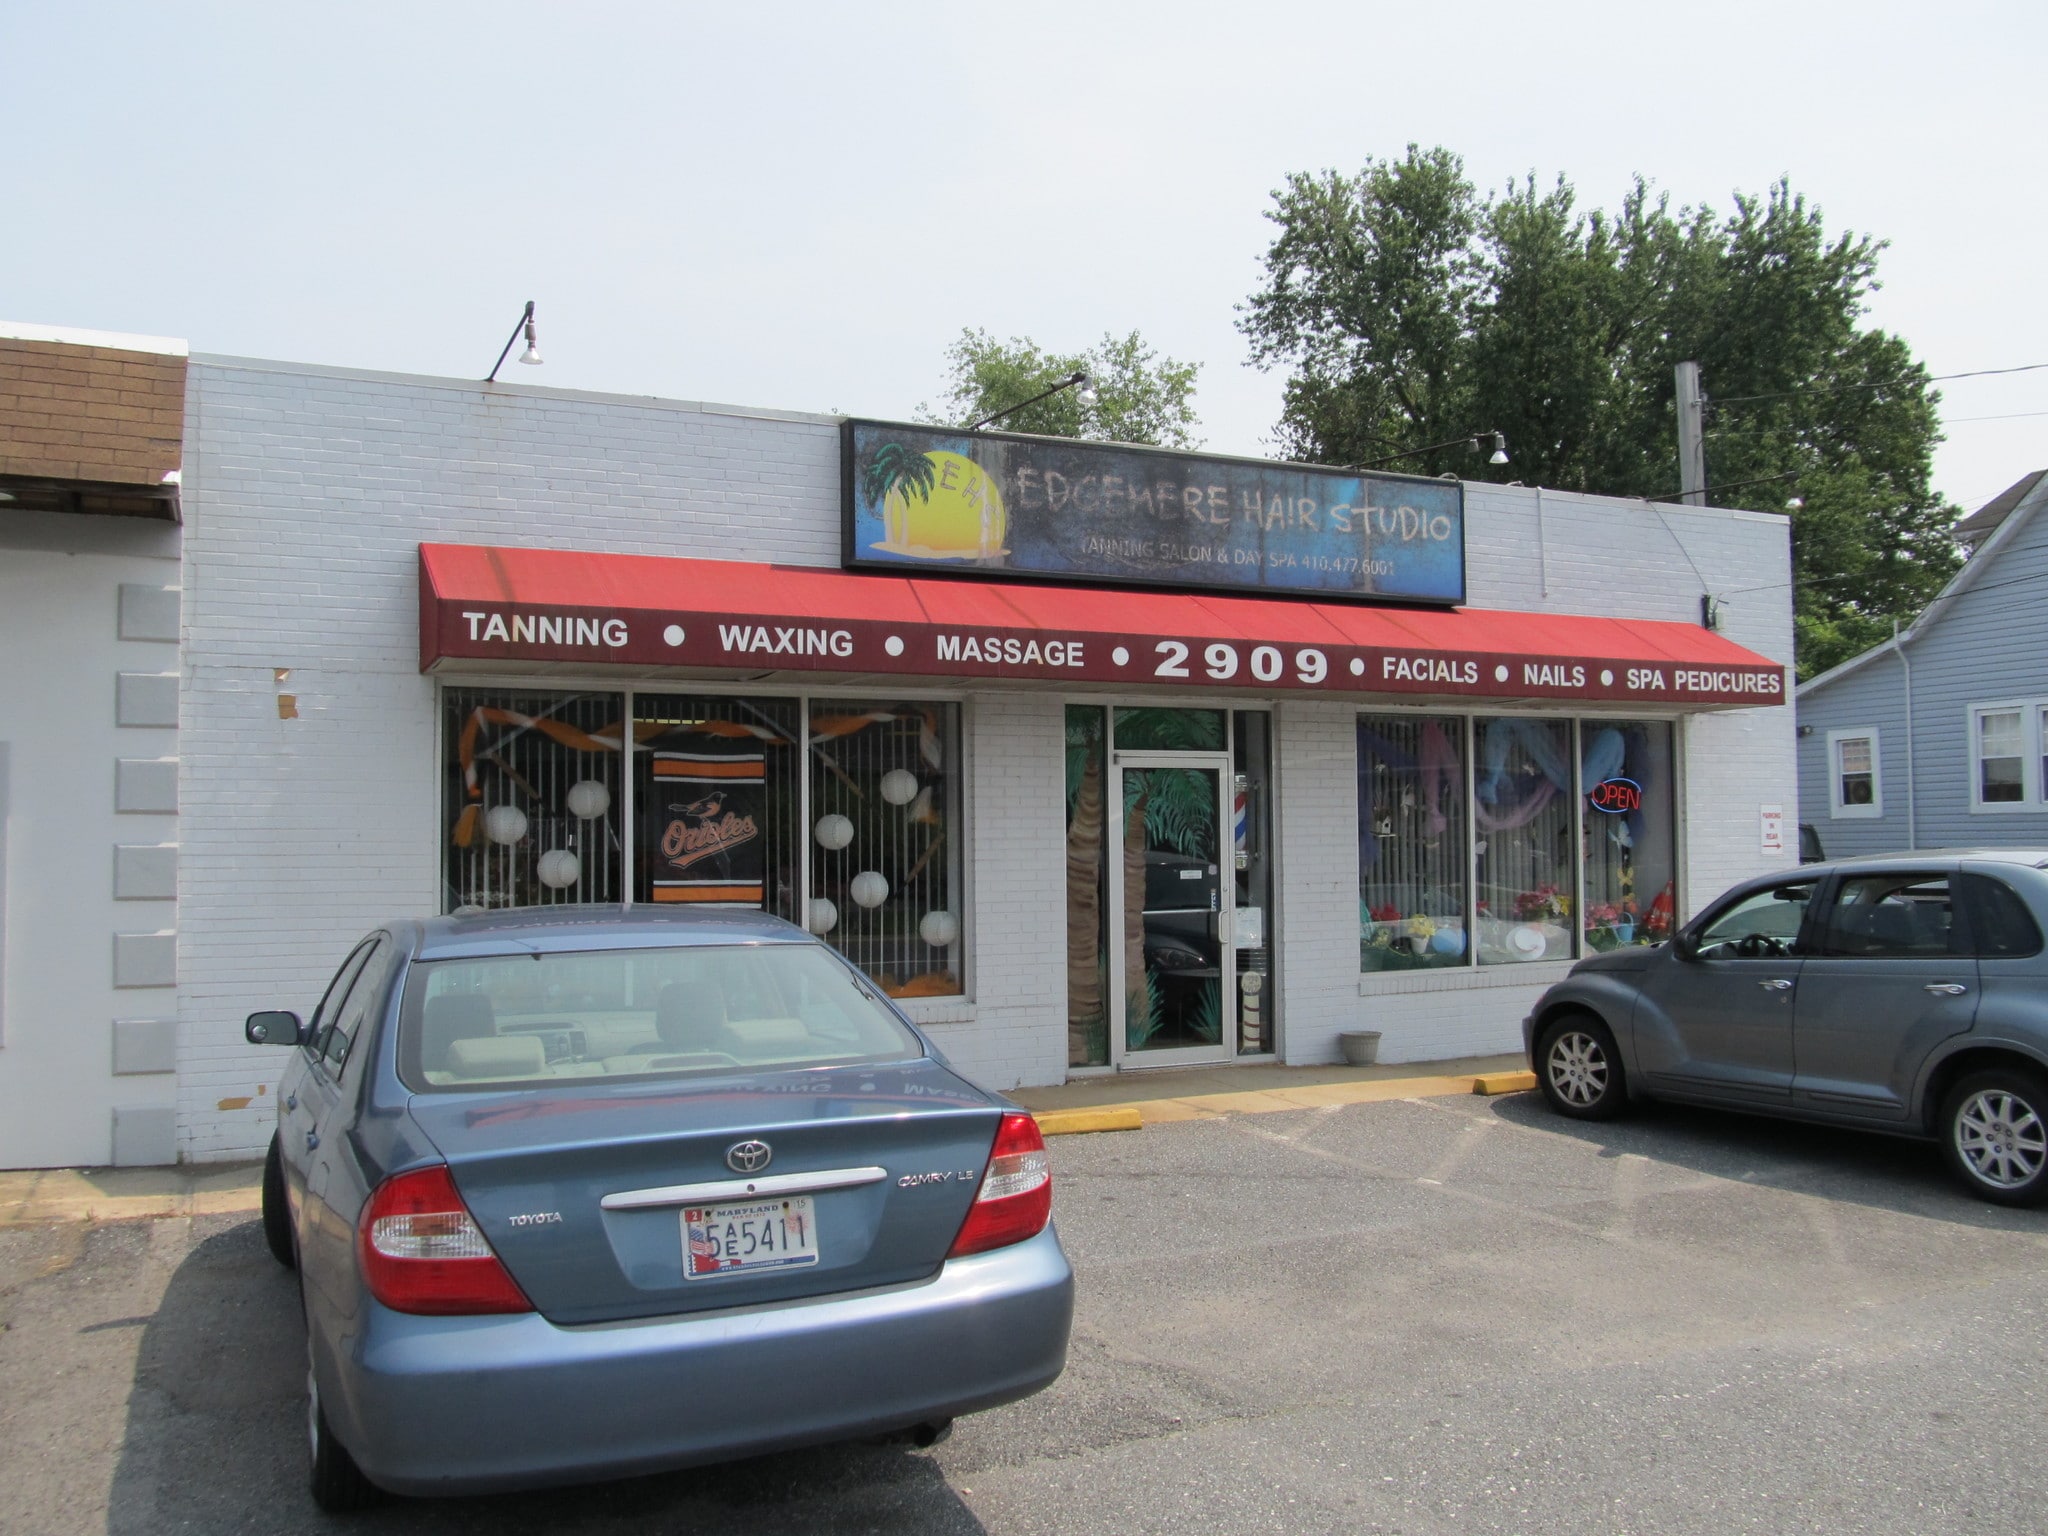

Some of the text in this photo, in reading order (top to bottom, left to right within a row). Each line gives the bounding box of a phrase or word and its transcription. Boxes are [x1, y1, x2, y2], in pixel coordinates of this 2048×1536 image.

[1243, 490, 1320, 533] HAIR
[1330, 503, 1451, 541] STUDIO
[1160, 543, 1212, 563] SALON
[1217, 549, 1228, 564] &
[1234, 550, 1263, 566] DAY
[1269, 552, 1297, 568] SPA
[462, 611, 1781, 695] TANNING WAXING MASSAGE 2909 FACIALS NAILS SPA PEDICURES
[1591, 782, 1642, 811] OPEN
[661, 811, 758, 859] Orioles
[897, 1170, 973, 1187] CAMRY LE
[508, 1211, 563, 1227] TOYOTA
[691, 1210, 698, 1220] 2
[716, 1204, 779, 1218] MARYLAND
